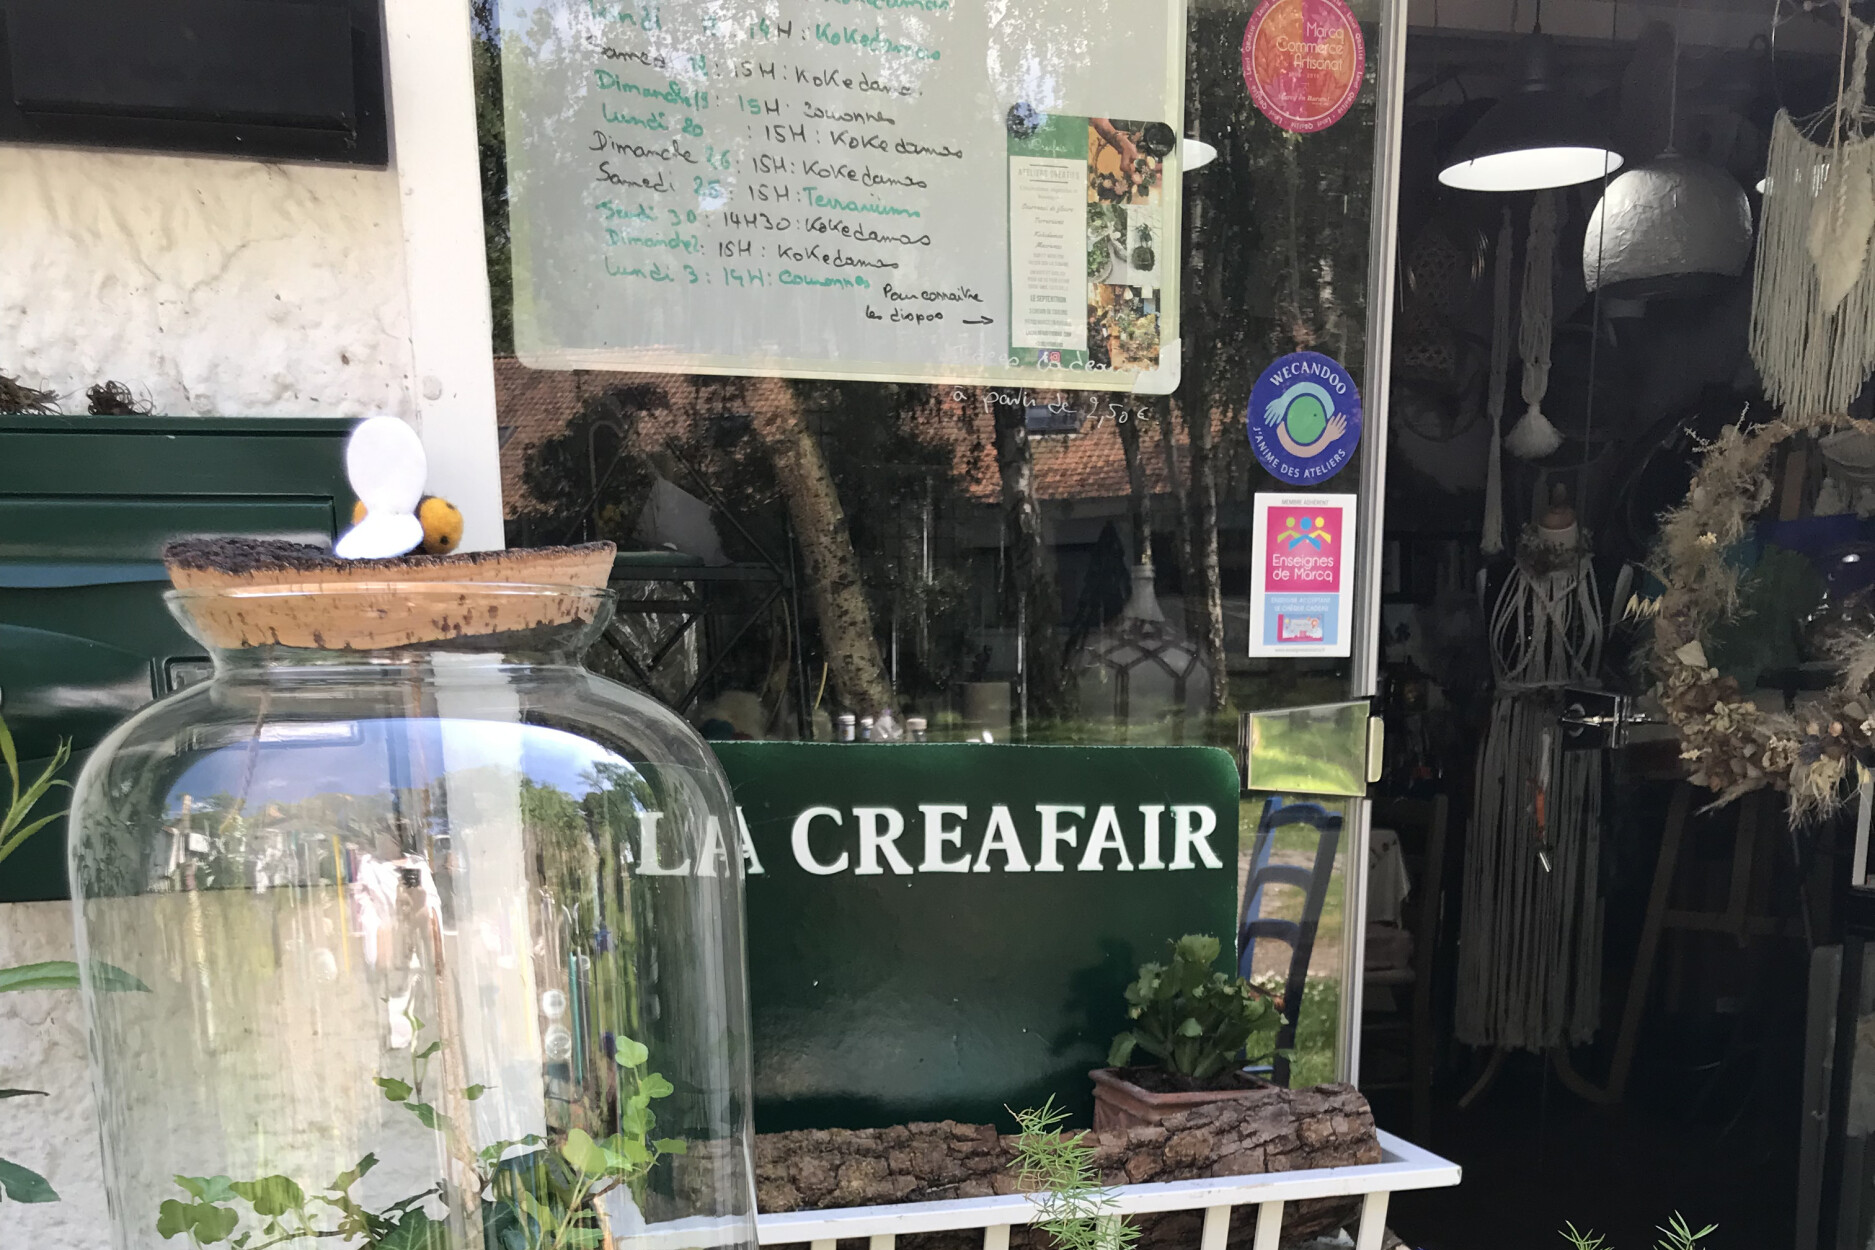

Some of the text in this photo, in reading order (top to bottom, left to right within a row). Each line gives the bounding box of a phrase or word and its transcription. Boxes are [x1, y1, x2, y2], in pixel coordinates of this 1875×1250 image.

[1306, 22, 1345, 44] Marcq
[1276, 36, 1345, 55] Commerce
[1293, 53, 1343, 71] Artisanat
[1269, 361, 1347, 395] WECANDOO
[1252, 426, 1346, 478] J'ANIME DES ATELIERS
[1272, 554, 1334, 569] Enseignes
[1272, 567, 1333, 583] de Marcq
[634, 803, 1224, 877] LA CREAFAIR
